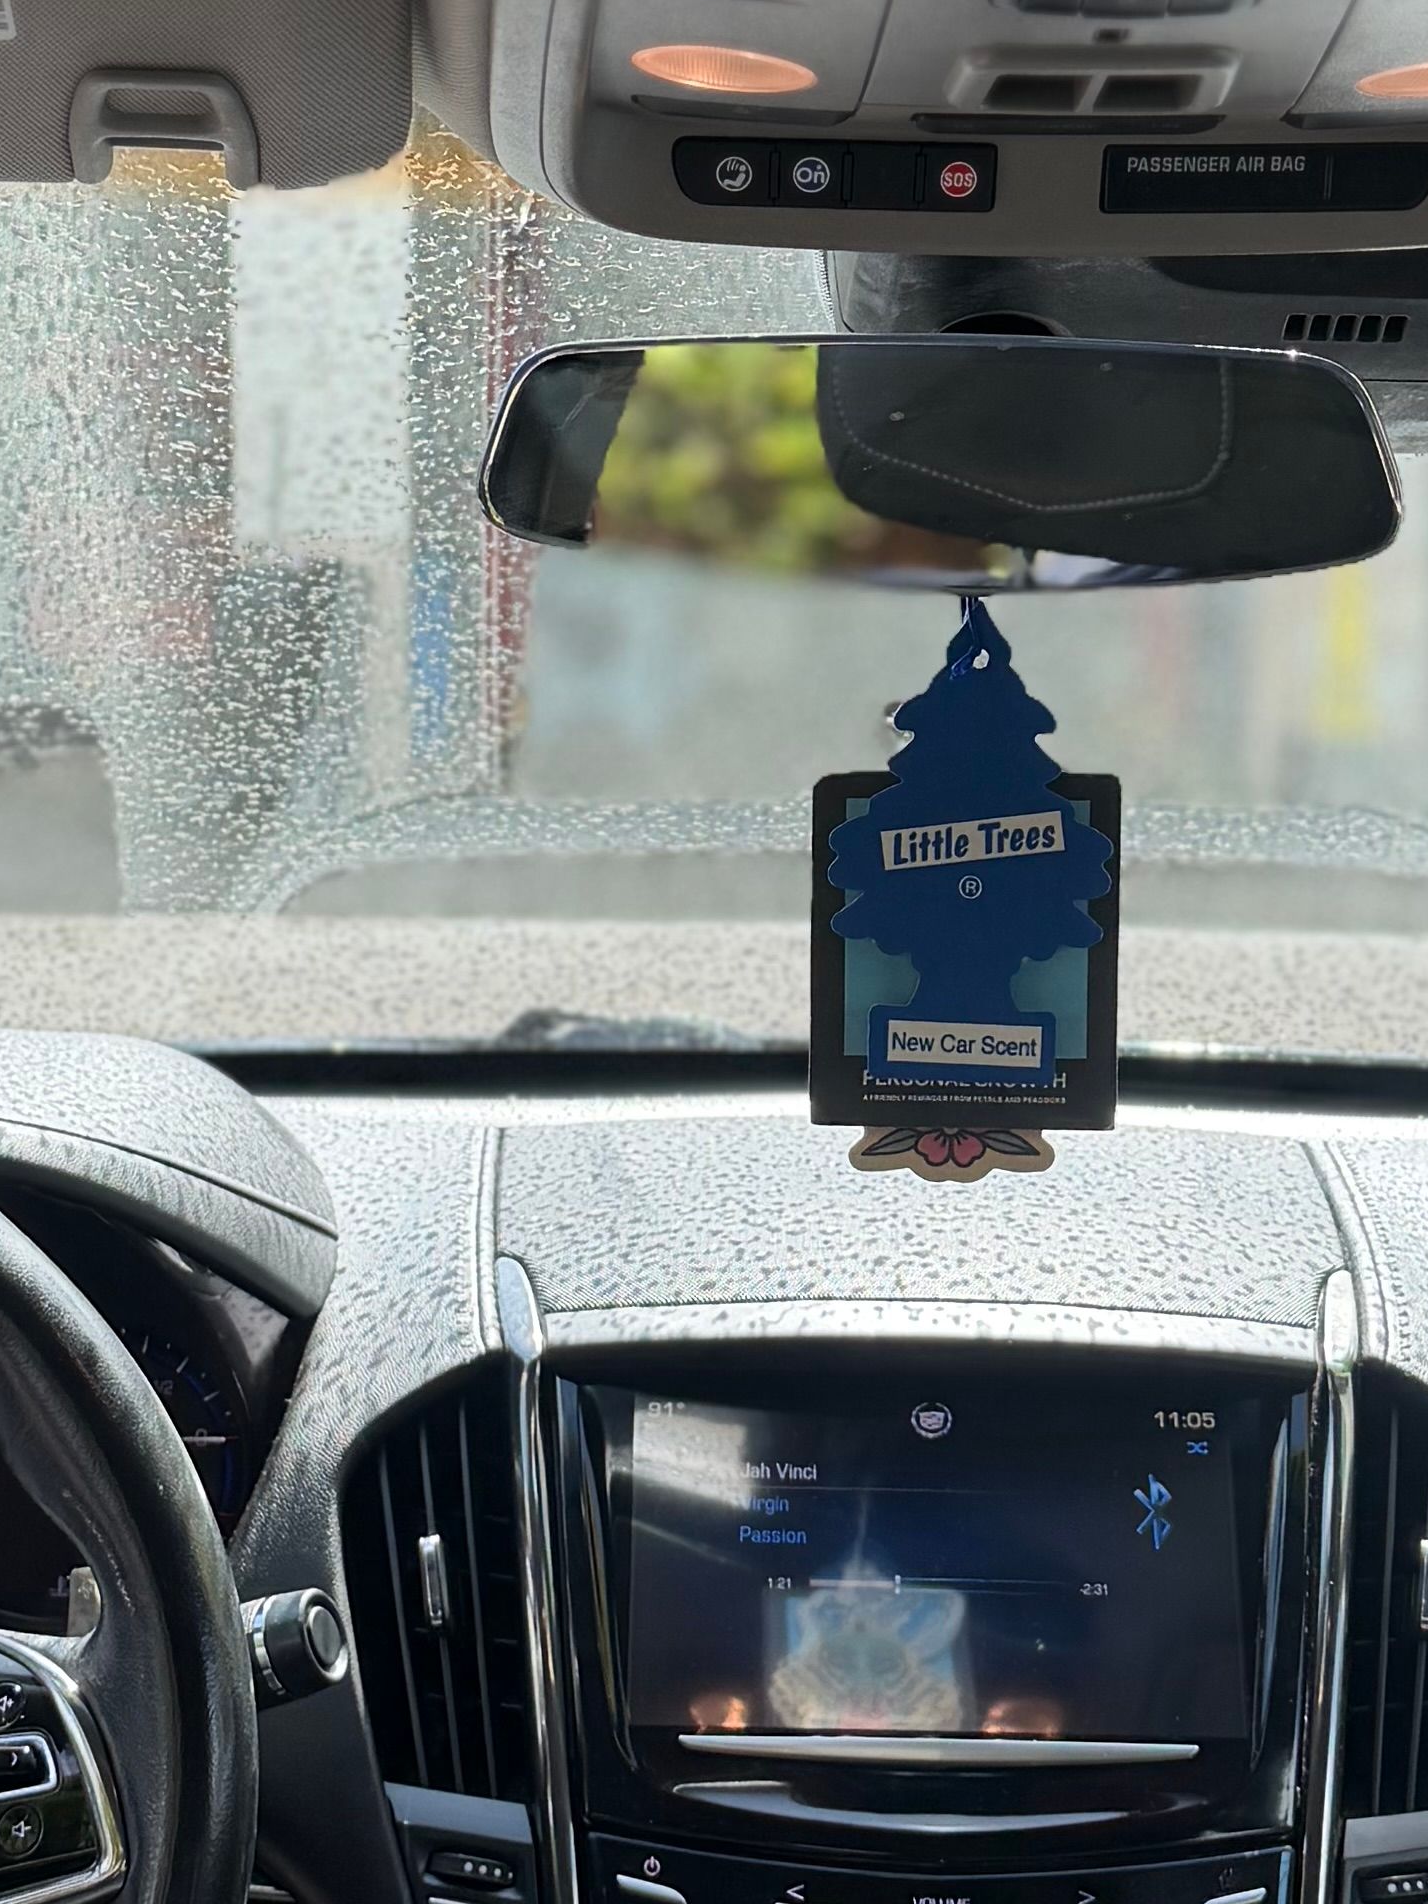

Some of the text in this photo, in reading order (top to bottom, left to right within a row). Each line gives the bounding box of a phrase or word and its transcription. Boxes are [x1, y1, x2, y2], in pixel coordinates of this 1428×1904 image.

[796, 164, 824, 183] On
[1126, 156, 1306, 173] PASSENGER AIR BAG
[943, 171, 973, 187] SOS
[891, 821, 1056, 866] Little Trees
[890, 1032, 1039, 1058] New Car Scent
[647, 1401, 685, 1417] 91°
[1154, 1411, 1215, 1429] 11:05
[740, 1462, 817, 1480] Jah Vinci
[739, 1525, 807, 1544] Passion
